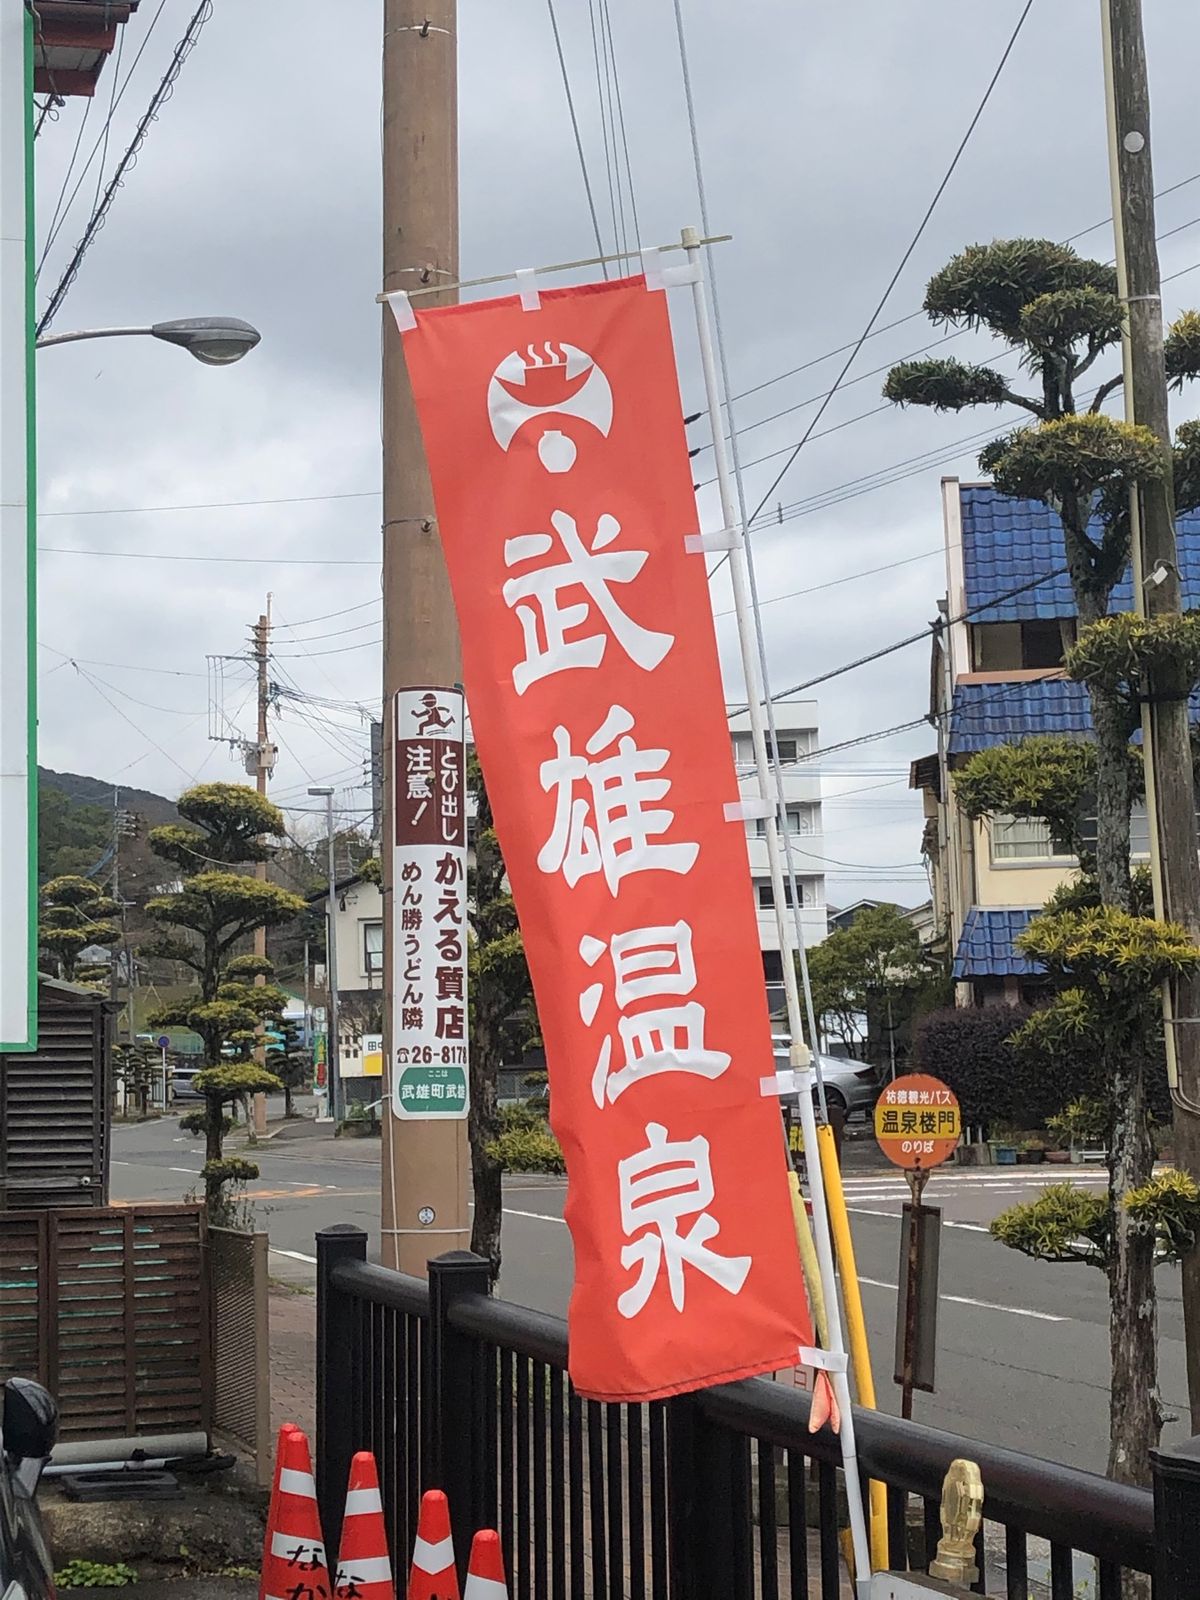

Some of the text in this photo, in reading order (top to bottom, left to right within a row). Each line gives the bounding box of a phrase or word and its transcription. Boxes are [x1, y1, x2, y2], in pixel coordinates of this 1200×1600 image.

[440, 746, 458, 841] とび出し
[502, 510, 752, 1320] 武雄温泉
[401, 862, 424, 1031] めん勝うどん隣
[433, 852, 465, 1040] かえる質店
[428, 1069, 449, 1078] ここは
[401, 1083, 466, 1100] 武雄町武雄
[886, 1090, 952, 1105] 祐徳観光バス
[881, 1110, 955, 1134] 温泉楼門
[901, 1140, 935, 1154] のりば
